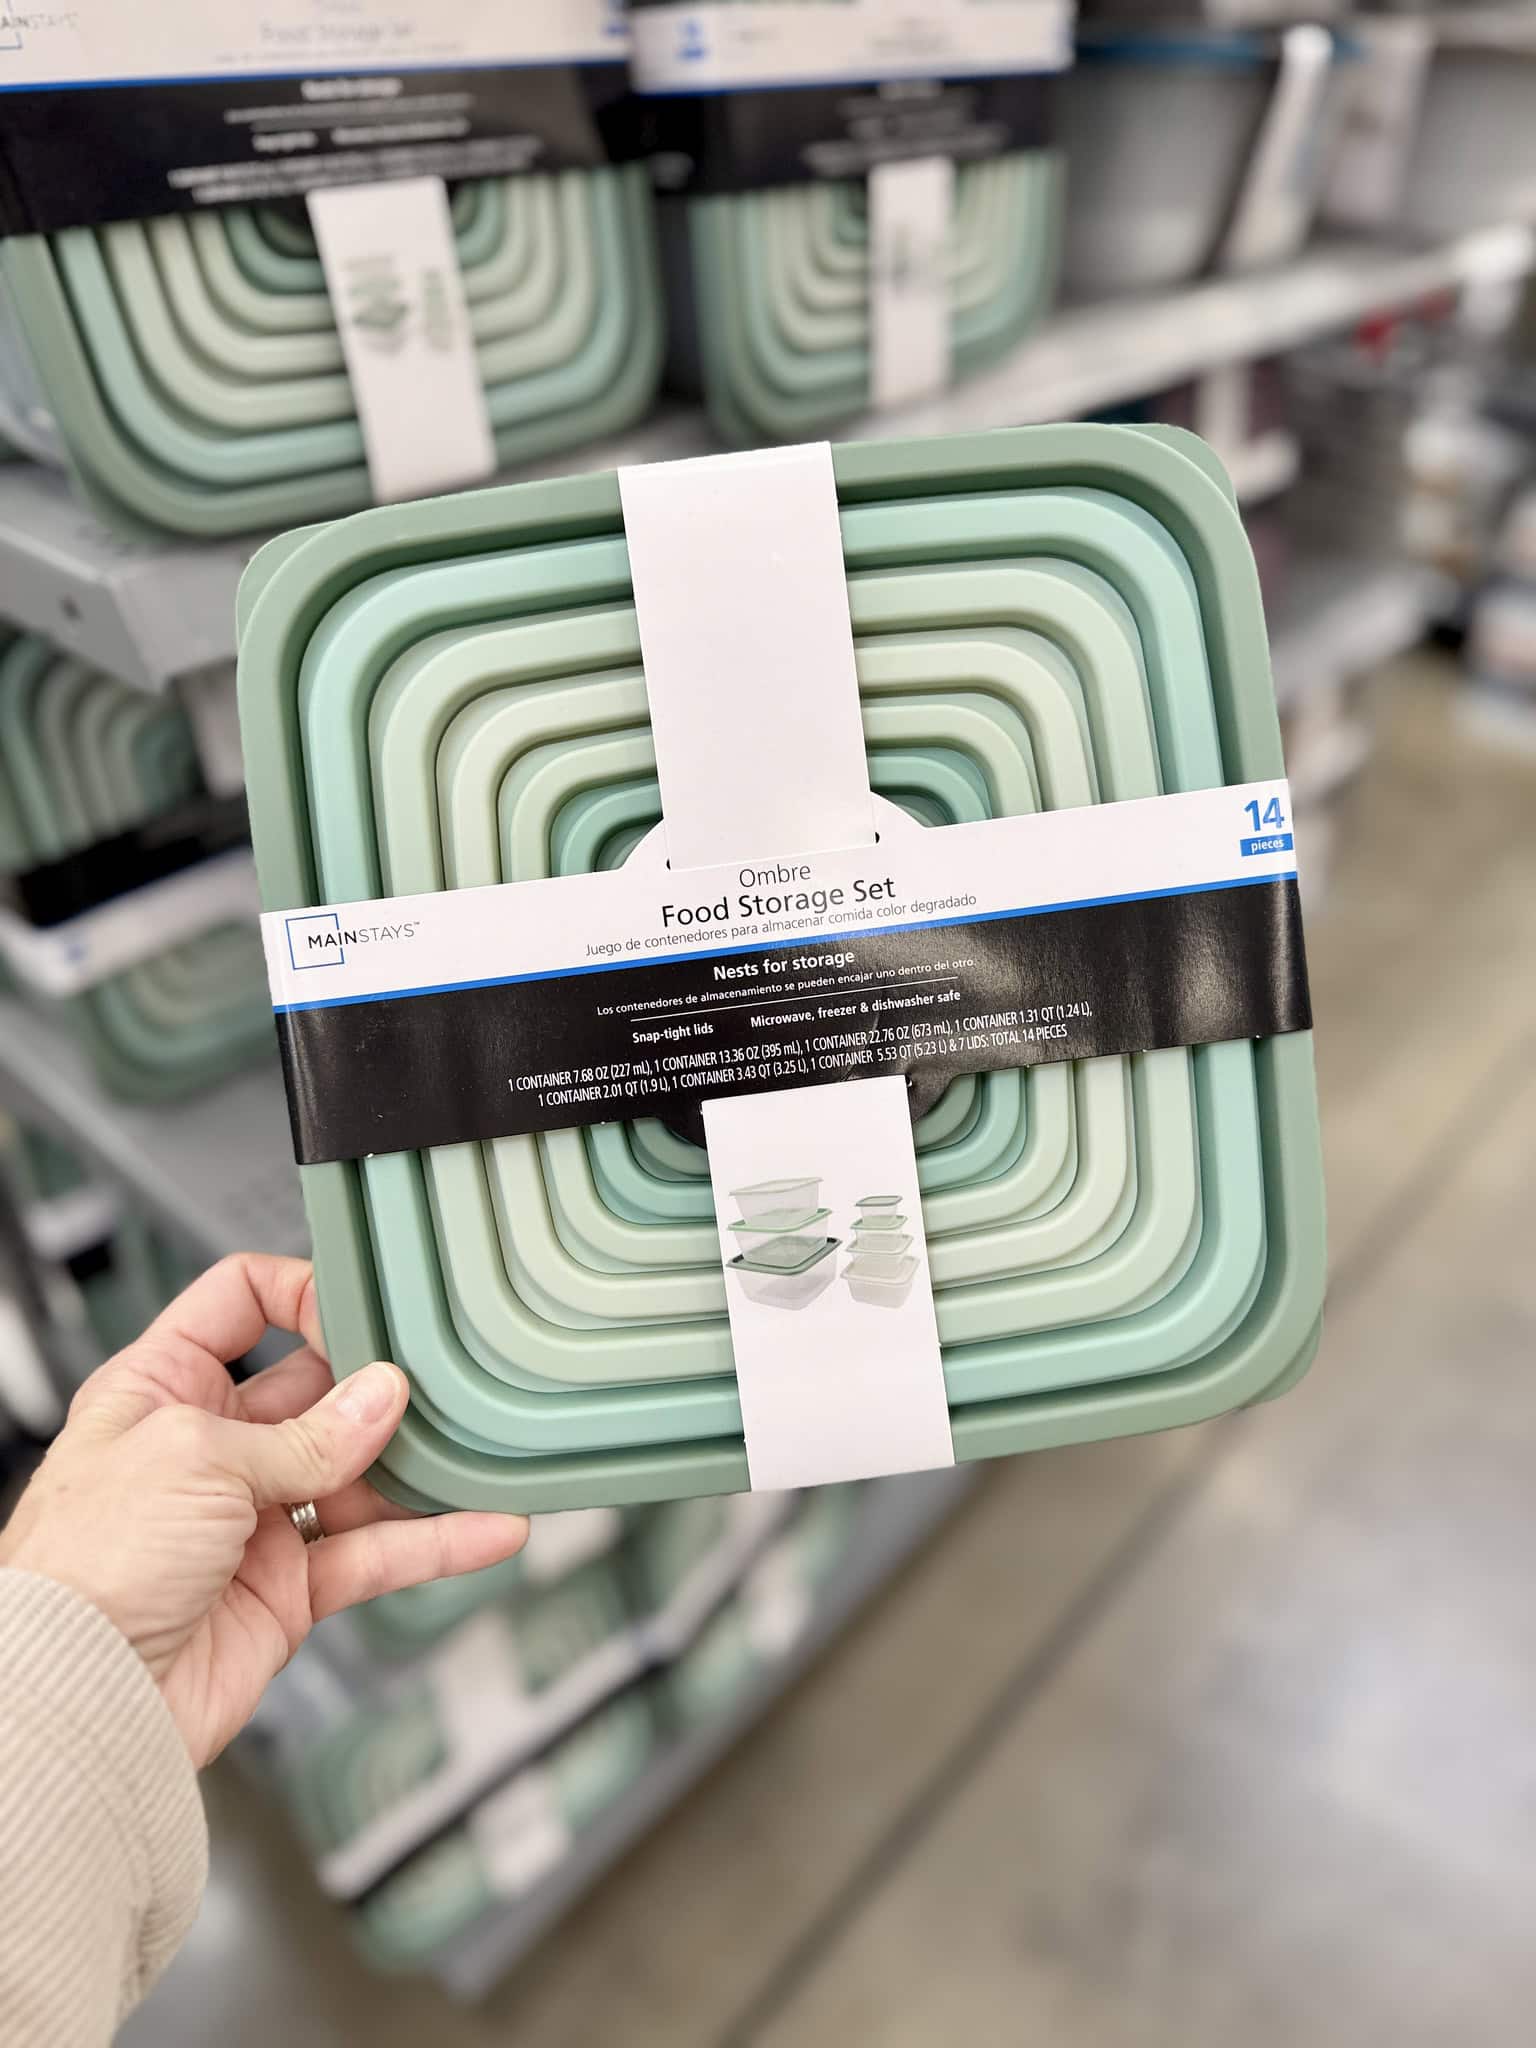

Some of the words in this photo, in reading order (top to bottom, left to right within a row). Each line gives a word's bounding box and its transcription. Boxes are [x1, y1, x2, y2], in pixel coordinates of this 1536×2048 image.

[1244, 797, 1285, 832] 14
[1251, 839, 1285, 854] pieces
[739, 863, 811, 888] Ombre
[662, 896, 729, 928] Food
[738, 886, 844, 918] Storage
[853, 877, 896, 902] Set
[586, 942, 622, 957] Juego
[626, 938, 641, 951] de
[645, 928, 728, 948] contenedores
[731, 923, 758, 942] para
[761, 914, 825, 933] almacenar
[828, 907, 873, 924] comida
[876, 903, 906, 918] color
[910, 894, 977, 914] degradado
[713, 964, 759, 981] Nests
[762, 958, 788, 975] for
[792, 951, 855, 971] storage
[597, 1006, 614, 1016] Los
[616, 996, 683, 1014] contenedores
[685, 993, 698, 1004] de
[700, 983, 782, 1003] almacenamiento
[784, 982, 795, 992] se
[797, 976, 835, 991] pueden
[838, 972, 873, 987] encajar
[876, 969, 896, 980] uno
[898, 963, 932, 977] dentro
[934, 960, 950, 971] del
[751, 1011, 815, 1028] Microwave,
[817, 1004, 857, 1020] freezer
[860, 1001, 869, 1013] &
[872, 993, 934, 1012] dishwasher
[937, 988, 961, 1004] safe
[508, 1078, 514, 1092] 1
[516, 1071, 572, 1091] CONTAINER
[573, 1068, 594, 1084] 7.68
[595, 1066, 609, 1080] OZ
[610, 1063, 630, 1079] (227
[633, 1059, 653, 1076] mL),
[654, 1059, 660, 1073] 1
[662, 1050, 718, 1071] CONTAINER
[718, 1047, 745, 1064] 13.36
[746, 1046, 760, 1060] OZ
[761, 1043, 781, 1060] (395
[783, 1039, 803, 1056] mL),
[805, 1039, 810, 1053] 1
[813, 1031, 868, 1051] CONTAINER
[869, 1026, 895, 1044] 22.76
[896, 1025, 910, 1039] OZ
[911, 1022, 932, 1039] (673
[934, 1018, 954, 1035] mL),
[955, 1019, 960, 1032] 1
[963, 1011, 1018, 1032] CONTAINER
[1019, 1009, 1039, 1024] 1.31
[1041, 1007, 1055, 1022] QT
[1055, 1003, 1080, 1021] (1.24
[1081, 1001, 1093, 1018] L),
[632, 1025, 691, 1044] Snap-tight
[694, 1021, 714, 1036] lids
[538, 1094, 544, 1107] 1
[546, 1086, 602, 1106] CONTAINER
[603, 1083, 623, 1099] 2.01
[625, 1081, 638, 1097] QT
[639, 1078, 657, 1095] (1.9
[659, 1076, 671, 1093] L),
[672, 1076, 678, 1089] 1
[680, 1068, 736, 1088] CONTAINER
[737, 1065, 757, 1081] 3.43
[758, 1064, 771, 1080] QT
[773, 1060, 796, 1077] (3.25
[798, 1057, 809, 1074] L),
[811, 1058, 816, 1071] 1
[818, 1050, 874, 1070] CONTAINER
[877, 1047, 897, 1062] 5.53
[899, 1045, 913, 1060] QT
[913, 1041, 937, 1059] (5.23
[939, 1039, 947, 1056] L)
[949, 1038, 957, 1053] &
[958, 1037, 965, 1050] 7
[967, 1034, 990, 1050] LIDS:
[990, 1029, 1021, 1046] TOTAL
[1022, 1028, 1034, 1042] 14
[1036, 1023, 1068, 1041] PIECES
